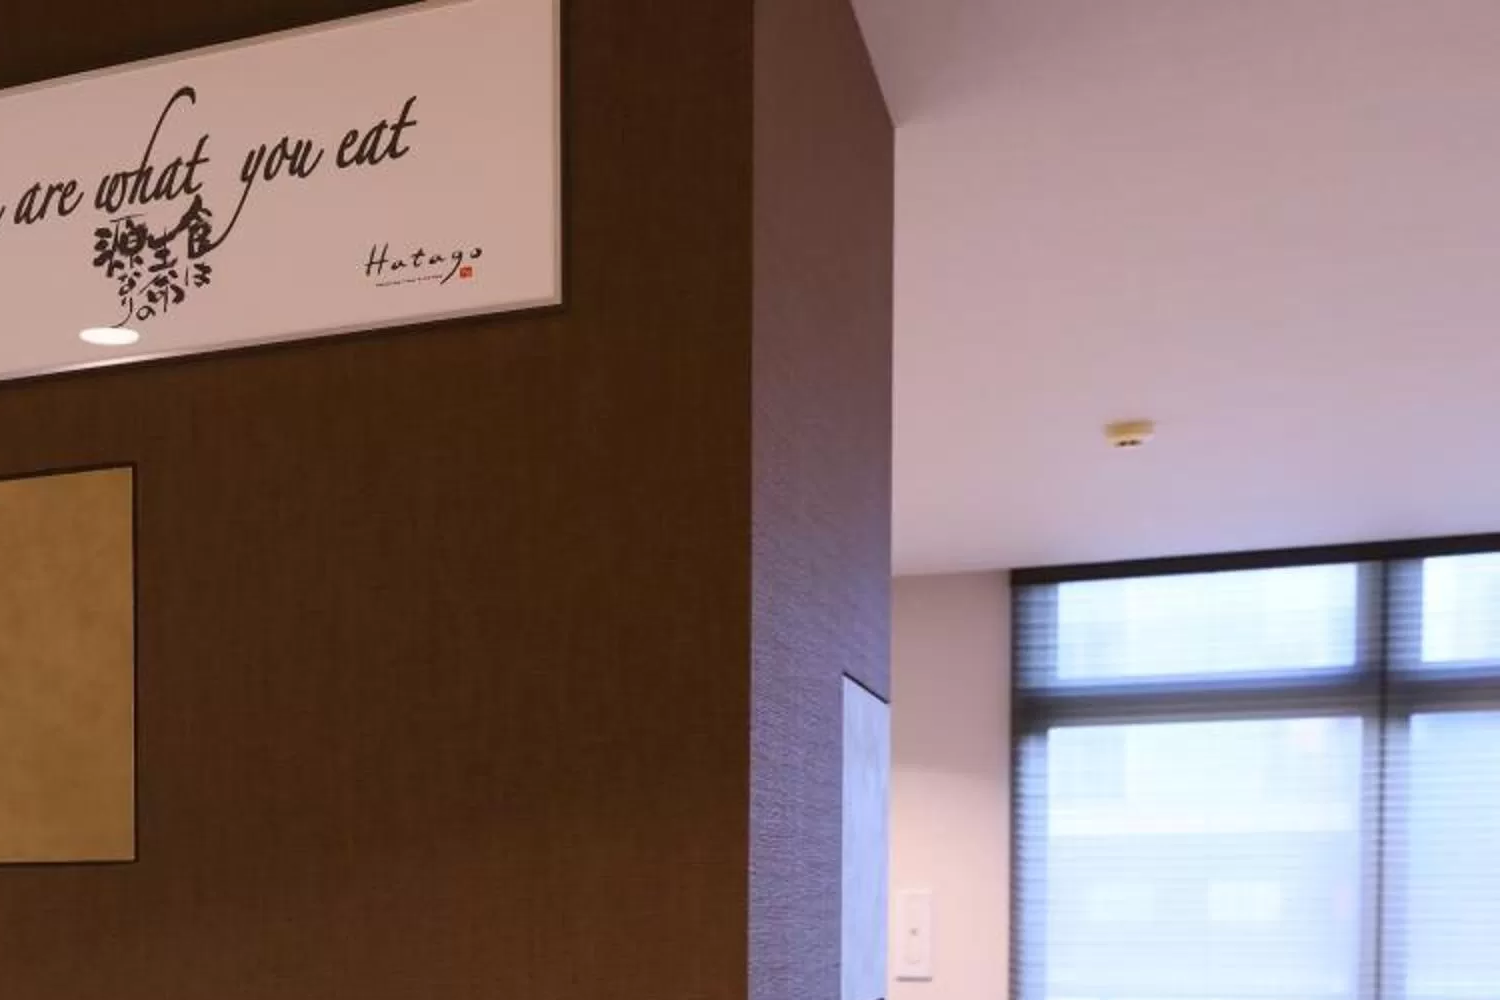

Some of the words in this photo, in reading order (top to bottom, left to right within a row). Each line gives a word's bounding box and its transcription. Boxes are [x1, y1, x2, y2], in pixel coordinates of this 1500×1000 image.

[14, 182, 84, 224] are
[94, 86, 209, 213] what
[336, 96, 417, 168] eat
[364, 241, 483, 285] Hatago
